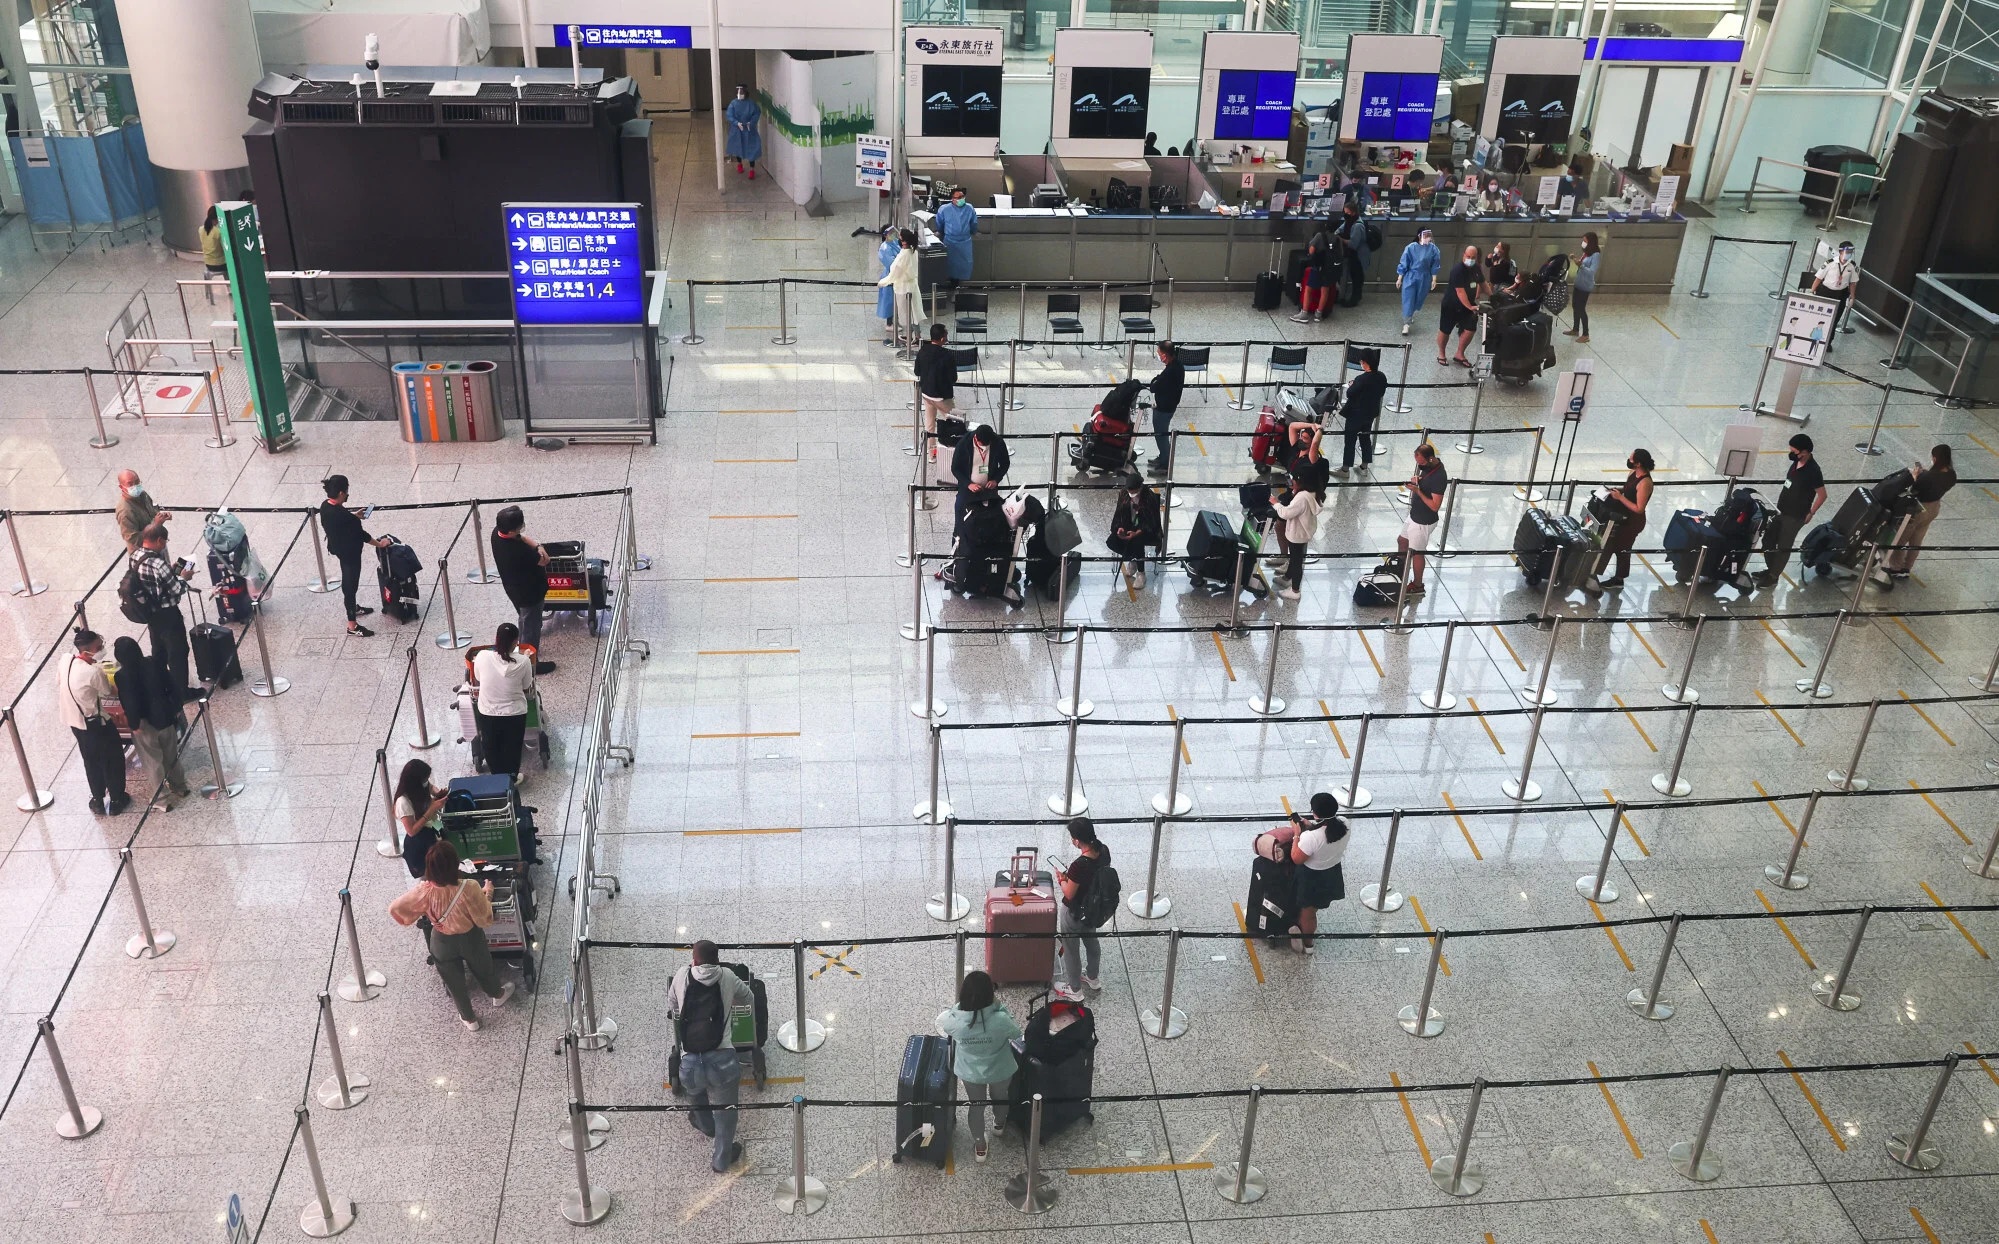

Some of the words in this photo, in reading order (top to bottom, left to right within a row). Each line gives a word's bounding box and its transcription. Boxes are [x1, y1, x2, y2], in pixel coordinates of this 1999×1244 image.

[940, 40, 994, 50] 永東旅行社
[910, 70, 918, 87] M01
[1059, 72, 1068, 90] M02
[1227, 94, 1246, 104] 專車
[1370, 96, 1389, 106] 專車
[1222, 106, 1250, 116] 登記處
[1364, 108, 1392, 117] 登記處
[1244, 175, 1252, 186] 4
[1320, 176, 1328, 187] 3
[1393, 176, 1400, 187] 2
[1466, 176, 1474, 188] 1
[546, 211, 630, 221] 往內地/澳門交通
[584, 235, 617, 245] 往市區
[552, 282, 584, 291] 停車場
[586, 282, 615, 298] 1,4
